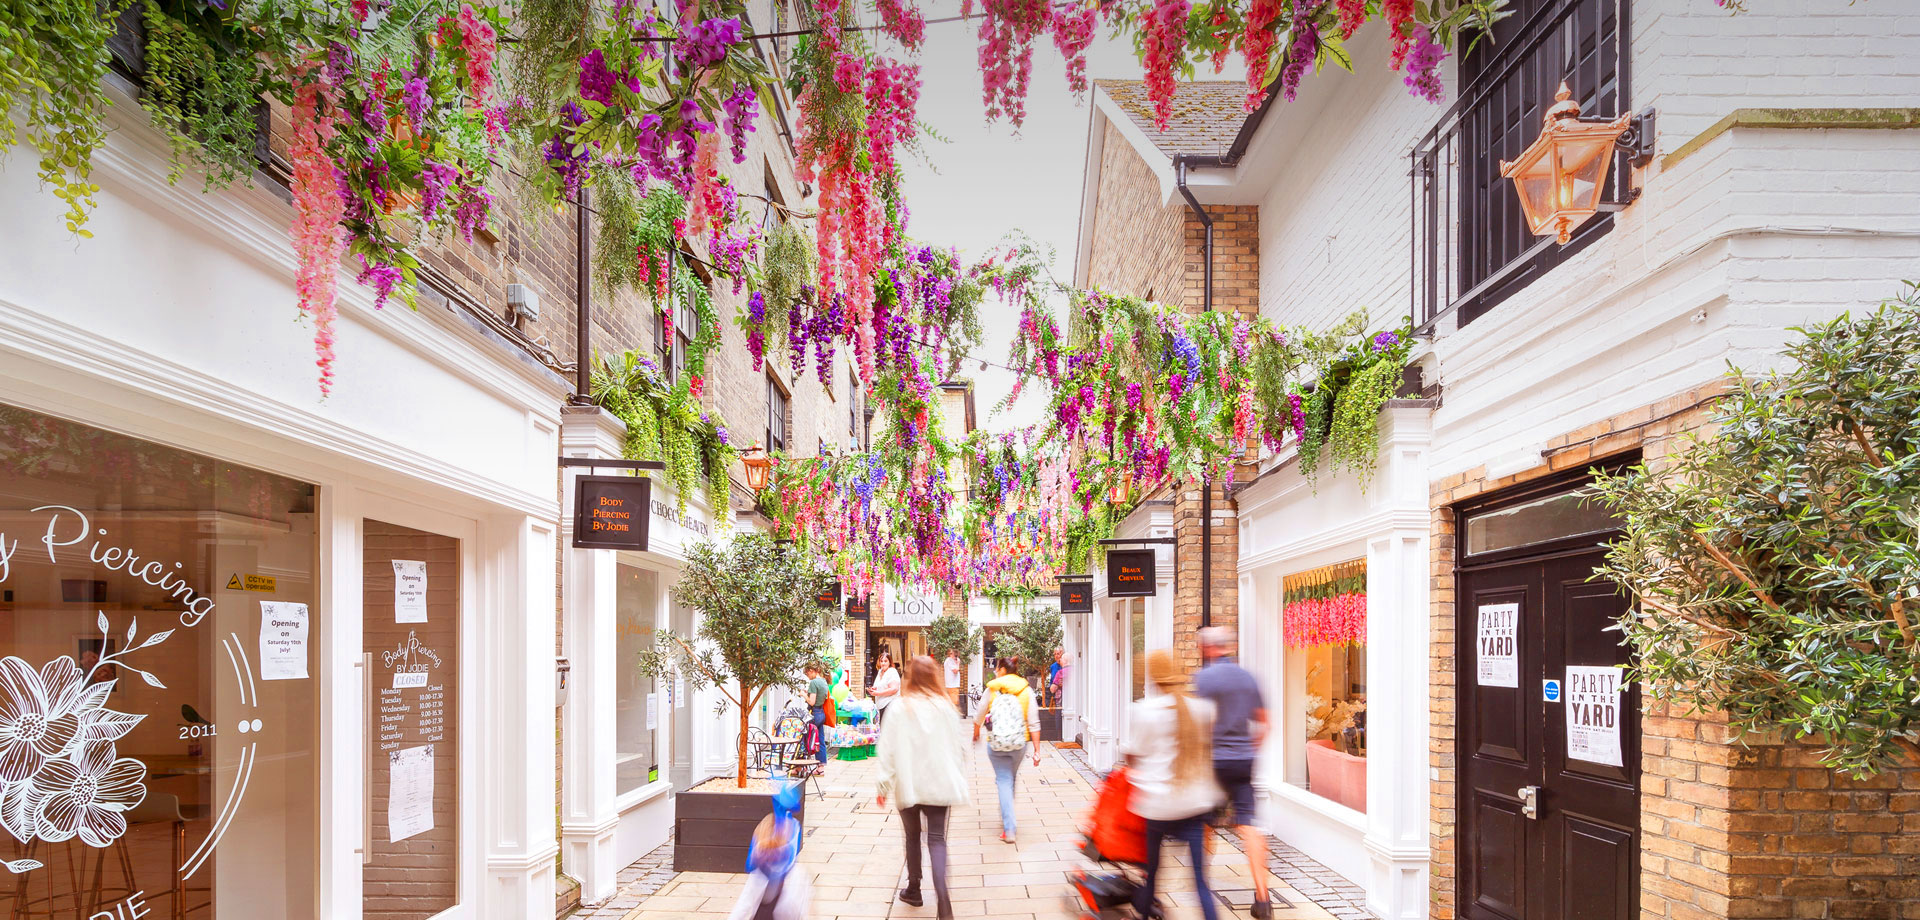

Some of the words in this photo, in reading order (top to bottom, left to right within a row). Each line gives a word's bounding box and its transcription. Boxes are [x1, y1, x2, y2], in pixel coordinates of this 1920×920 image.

[600, 496, 623, 506] BODY
[593, 508, 630, 519] PIERCING
[593, 521, 605, 530] BY
[606, 521, 629, 531] JODIE
[30, 505, 215, 627] Piercing
[248, 576, 266, 584] CCTV
[1118, 574, 1145, 582] CHEVEUX
[245, 583, 275, 591] operation
[893, 599, 934, 615] LION
[271, 620, 300, 628] Opening
[1481, 610, 1513, 629] PARTY
[1495, 628, 1513, 636] THE
[1481, 636, 1513, 656] YARD
[381, 642, 408, 669] Body
[408, 637, 442, 669] Piercing
[396, 664, 406, 673] BY
[408, 663, 429, 673] JODIE
[395, 675, 426, 686] CLOSED
[1572, 673, 1615, 694] PARTY
[1572, 694, 1585, 702] IN
[1591, 694, 1615, 704] THE
[1572, 702, 1615, 728] YARD
[179, 723, 218, 740] 2011
